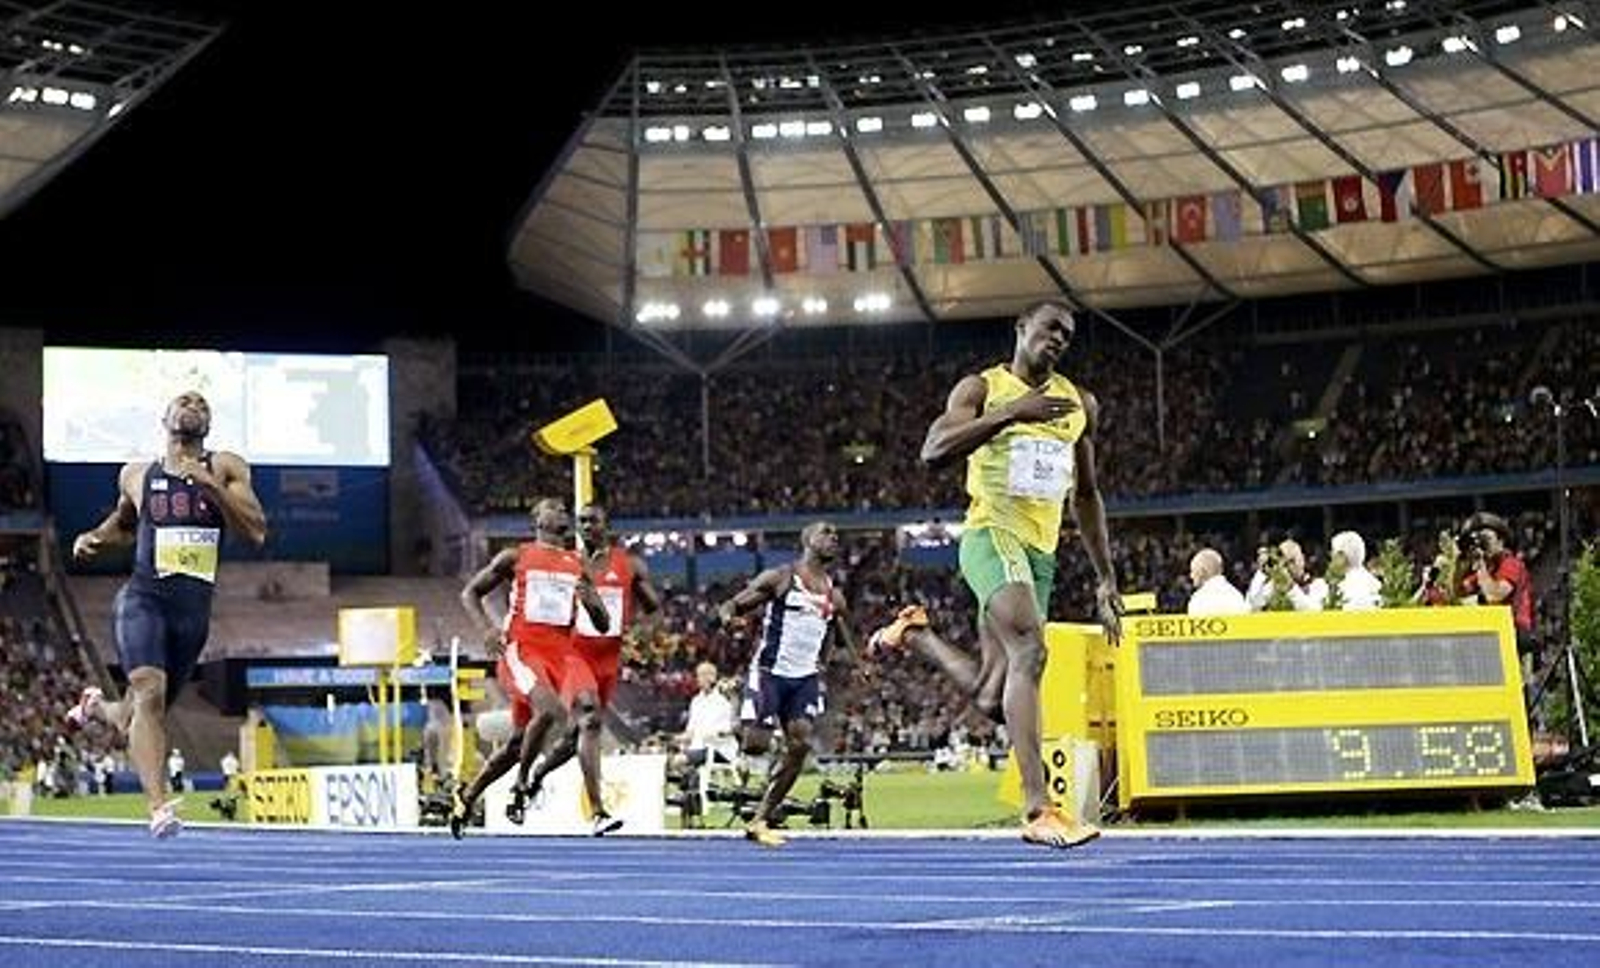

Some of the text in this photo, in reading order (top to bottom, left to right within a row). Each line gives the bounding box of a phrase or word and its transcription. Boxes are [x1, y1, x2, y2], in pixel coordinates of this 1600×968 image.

[1135, 618, 1229, 638] SEIKO
[1154, 707, 1250, 728] SEIKO
[1326, 724, 1507, 780] 9.58
[253, 774, 309, 824] SEIKO
[326, 772, 398, 827] EPSON
